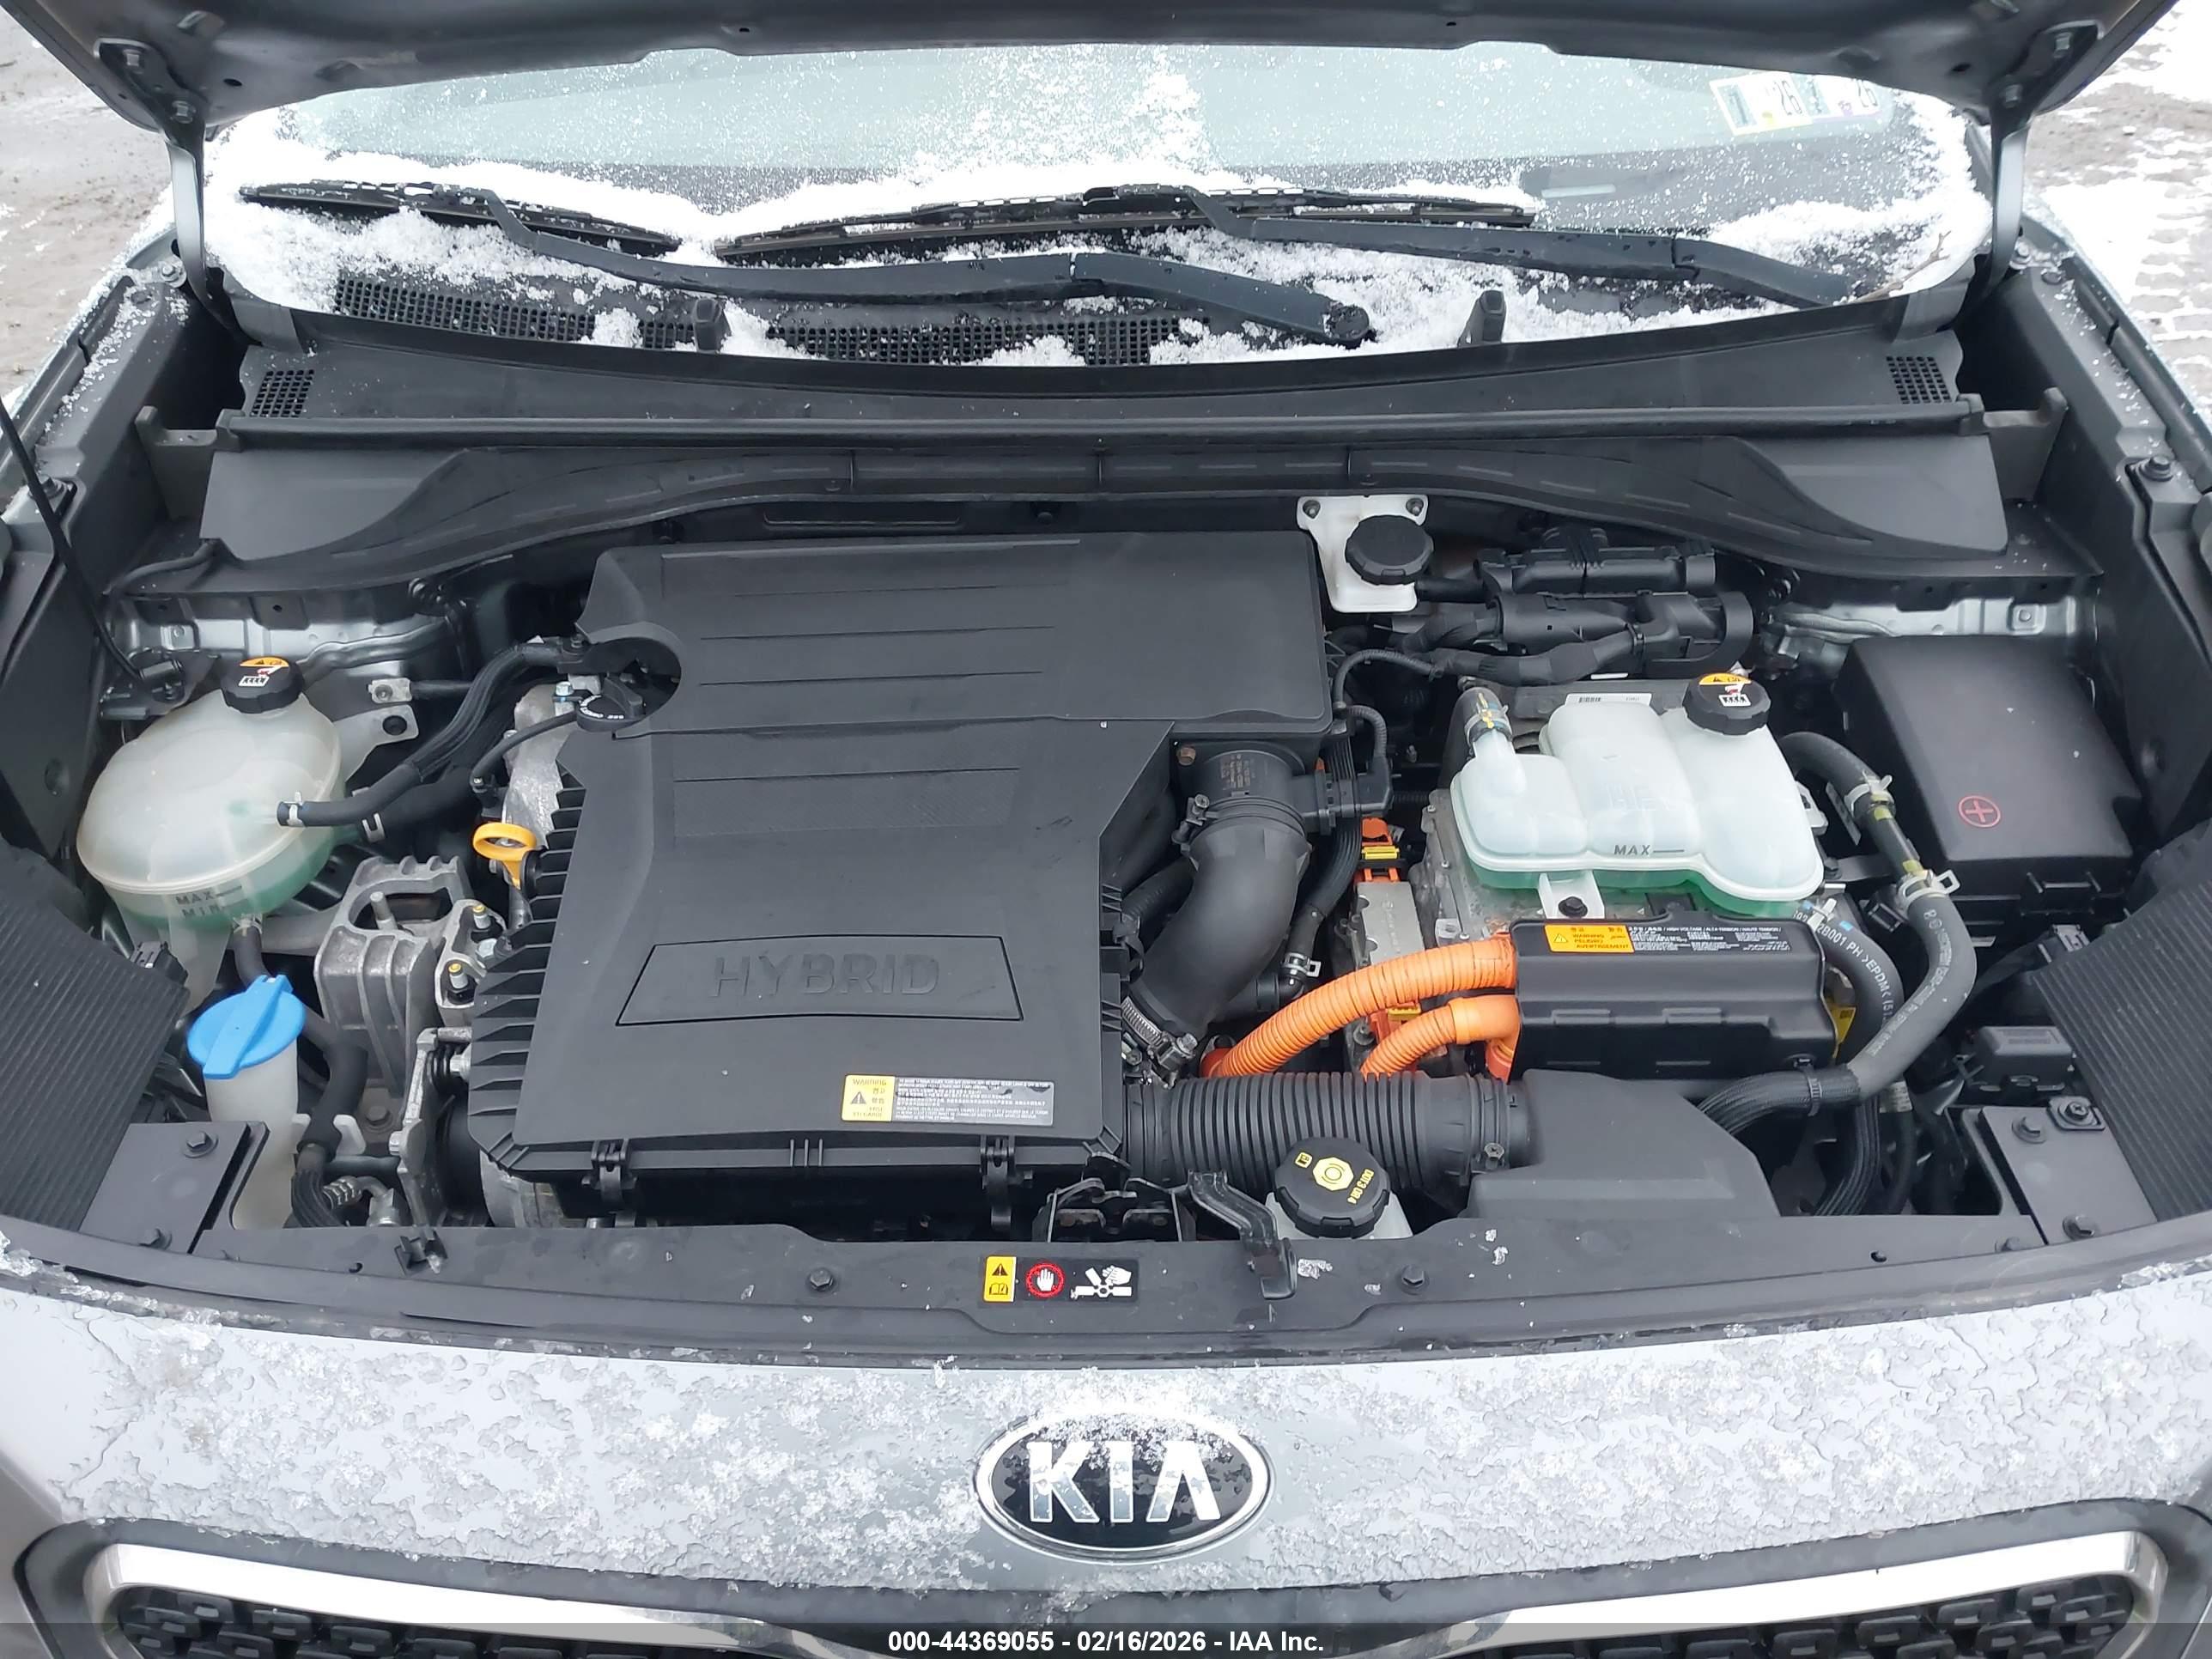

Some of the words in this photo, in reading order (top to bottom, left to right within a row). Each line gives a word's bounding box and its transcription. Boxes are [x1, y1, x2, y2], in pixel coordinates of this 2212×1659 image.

[1613, 844, 1651, 856] MAX
[174, 890, 215, 905] MAX
[181, 903, 221, 917] MIN
[1846, 941, 1864, 957] PH
[710, 953, 939, 997] HYBRID
[1027, 1441, 1221, 1522] KIA
